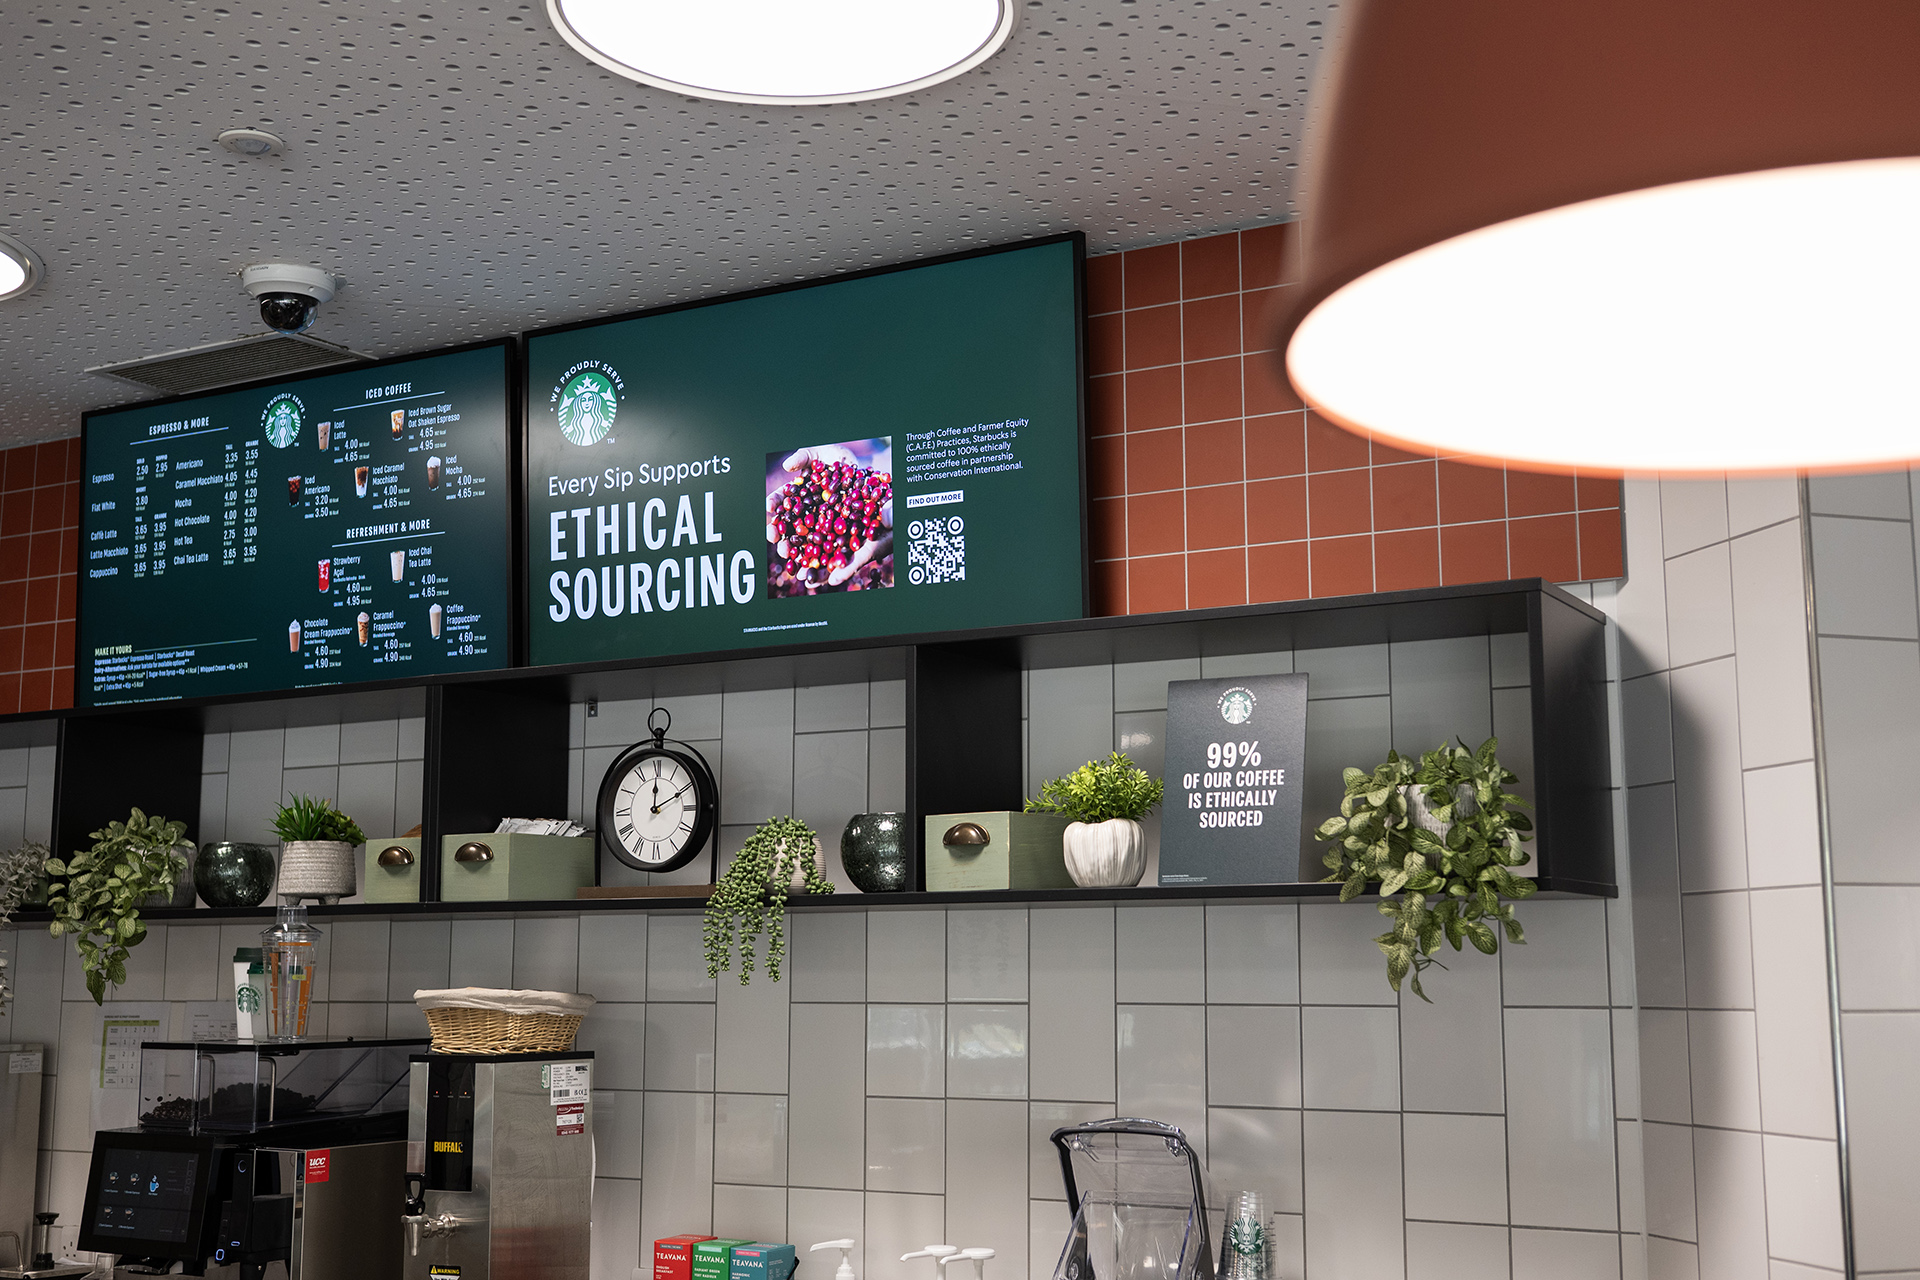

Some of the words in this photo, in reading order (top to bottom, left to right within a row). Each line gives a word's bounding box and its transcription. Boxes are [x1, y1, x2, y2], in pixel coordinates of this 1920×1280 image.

[550, 386, 561, 402] WE
[560, 360, 600, 384] PROUDLY
[602, 363, 624, 390] SERVE
[366, 388, 382, 399] ICED
[385, 382, 412, 396] COFFEE
[409, 408, 419, 417] Iced
[420, 406, 436, 416] Brown
[437, 404, 452, 413] Sugar
[149, 421, 182, 435] ESPRESSO
[183, 420, 189, 430] &
[191, 416, 210, 428] MORE
[334, 420, 345, 429] Iced
[408, 420, 417, 428] Oat
[418, 416, 436, 426] Shaken
[437, 414, 460, 424] Espresso
[420, 427, 434, 438] 4.65
[906, 430, 935, 441] Through
[937, 427, 960, 437] Coffee
[963, 424, 976, 433] and
[978, 422, 1004, 431] Farmer
[1006, 418, 1029, 428] Equity
[334, 432, 346, 440] Latte
[937, 437, 972, 447] Practices,
[973, 431, 1008, 443] Starbucks
[1010, 430, 1016, 438] is
[345, 439, 358, 449] 4.00
[420, 440, 434, 450] 4.95
[345, 451, 358, 462] 4.65
[906, 450, 946, 462] committed
[958, 445, 978, 455] 100%
[980, 441, 1011, 452] ethically
[176, 460, 203, 470] Americano
[225, 452, 238, 463] 3.35
[245, 449, 258, 460] 3.55
[446, 455, 457, 464] Iced
[906, 462, 935, 472] sourced
[937, 458, 960, 468] coffee
[970, 452, 1014, 466] partnership
[92, 473, 114, 484] Espresso
[136, 465, 148, 476] 2.50
[156, 462, 167, 472] 2.95
[373, 467, 383, 475] Iced
[384, 463, 404, 473] Caramel
[445, 466, 463, 475] Mocha
[907, 474, 922, 482] with
[924, 468, 972, 481] Conservation
[974, 461, 1024, 474] International.
[175, 478, 196, 490] Caramel
[197, 475, 224, 486] Macchiato
[225, 471, 237, 482] 4.05
[245, 468, 258, 479] 4.45
[305, 476, 315, 484] Iced
[373, 475, 398, 485] Macchiato
[457, 475, 472, 485] 4.00
[549, 476, 598, 496] Every
[603, 467, 634, 491] Sip
[639, 455, 731, 486] Supports
[304, 485, 330, 495] Americano
[384, 485, 398, 496] 4.00
[457, 487, 472, 498] 4.65
[175, 498, 192, 508] Mocha
[224, 490, 237, 501] 4.00
[245, 488, 257, 498] 4.20
[315, 494, 328, 505] 3.20
[941, 493, 961, 501] MORE
[384, 498, 398, 508] 4.65
[175, 518, 183, 527] Hot
[184, 514, 210, 526] Chocolate
[224, 510, 237, 520] 4.00
[244, 507, 257, 517] 4.20
[315, 507, 328, 518] 3.50
[346, 523, 398, 539] REFRESHMENT
[401, 522, 407, 532] &
[409, 519, 430, 531] MORE
[550, 491, 722, 562] ETHICAL
[174, 537, 183, 546] Hot
[184, 536, 193, 545] Tea
[224, 529, 235, 540] 2.75
[244, 526, 257, 537] 3.00
[409, 548, 419, 557] Iced
[421, 546, 432, 555] Chai
[333, 556, 361, 566] Strawberry
[409, 560, 417, 568] Tea
[418, 558, 431, 567] Latte
[422, 574, 436, 584] 4.00
[346, 583, 360, 593] 4.60
[549, 549, 756, 623] SOURCING
[422, 587, 436, 597] 4.65
[346, 596, 360, 606] 4.95
[446, 604, 464, 614] Coffee
[373, 610, 394, 620] Caramel
[304, 618, 328, 628] Chocolate
[304, 630, 320, 639] Cream
[459, 632, 473, 642] 4.60
[384, 639, 398, 649] 4.60
[95, 647, 108, 656] MAKE
[110, 646, 114, 655] IT
[115, 645, 132, 654] YOURS
[315, 645, 328, 656] 4.60
[459, 645, 473, 656] 4.90
[384, 652, 398, 662] 4.90
[315, 658, 328, 669] 4.90
[1207, 741, 1262, 768] 99%
[1183, 773, 1200, 789] OF
[1204, 772, 1232, 788] OUR
[1236, 769, 1284, 787] COFFEE
[1188, 793, 1202, 809] IS
[1206, 790, 1277, 808] ETHICALLY
[1199, 810, 1263, 828] SOURCED
